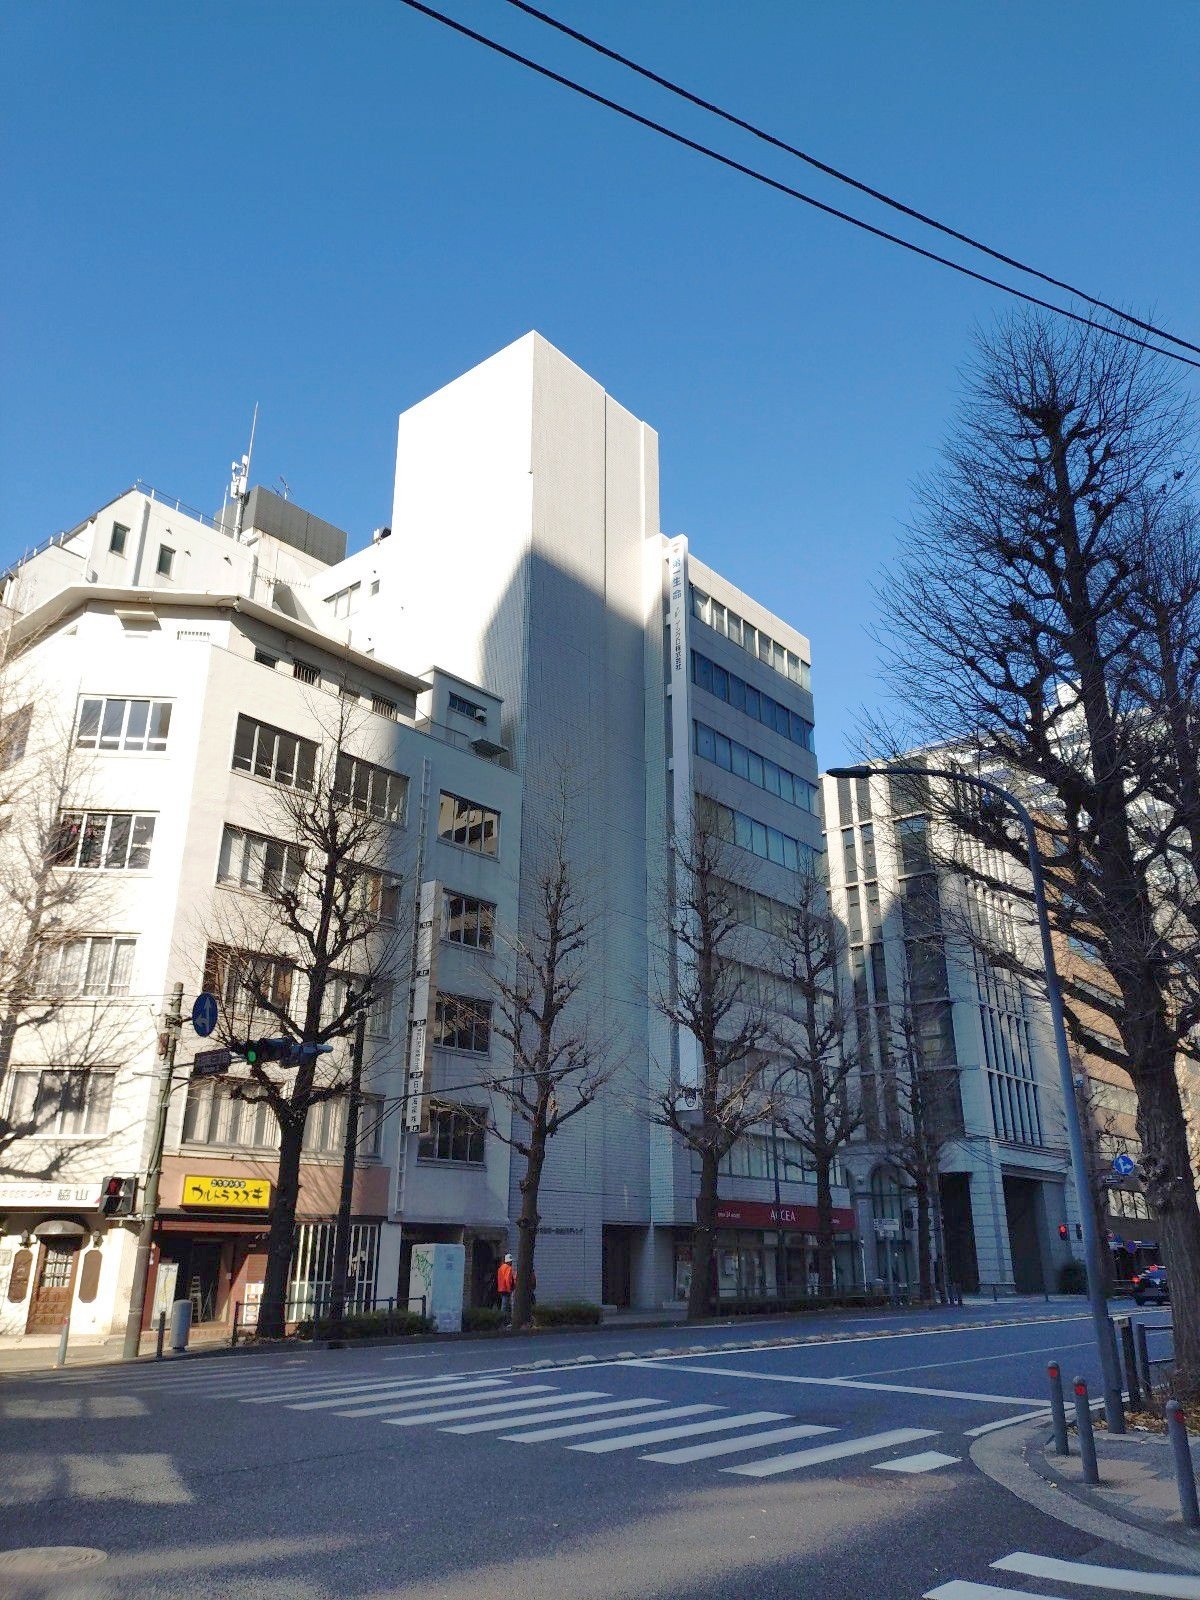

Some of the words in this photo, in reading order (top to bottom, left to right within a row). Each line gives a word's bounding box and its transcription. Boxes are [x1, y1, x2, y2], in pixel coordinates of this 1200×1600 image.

[191, 1184, 264, 1205] ウルトラスズキ
